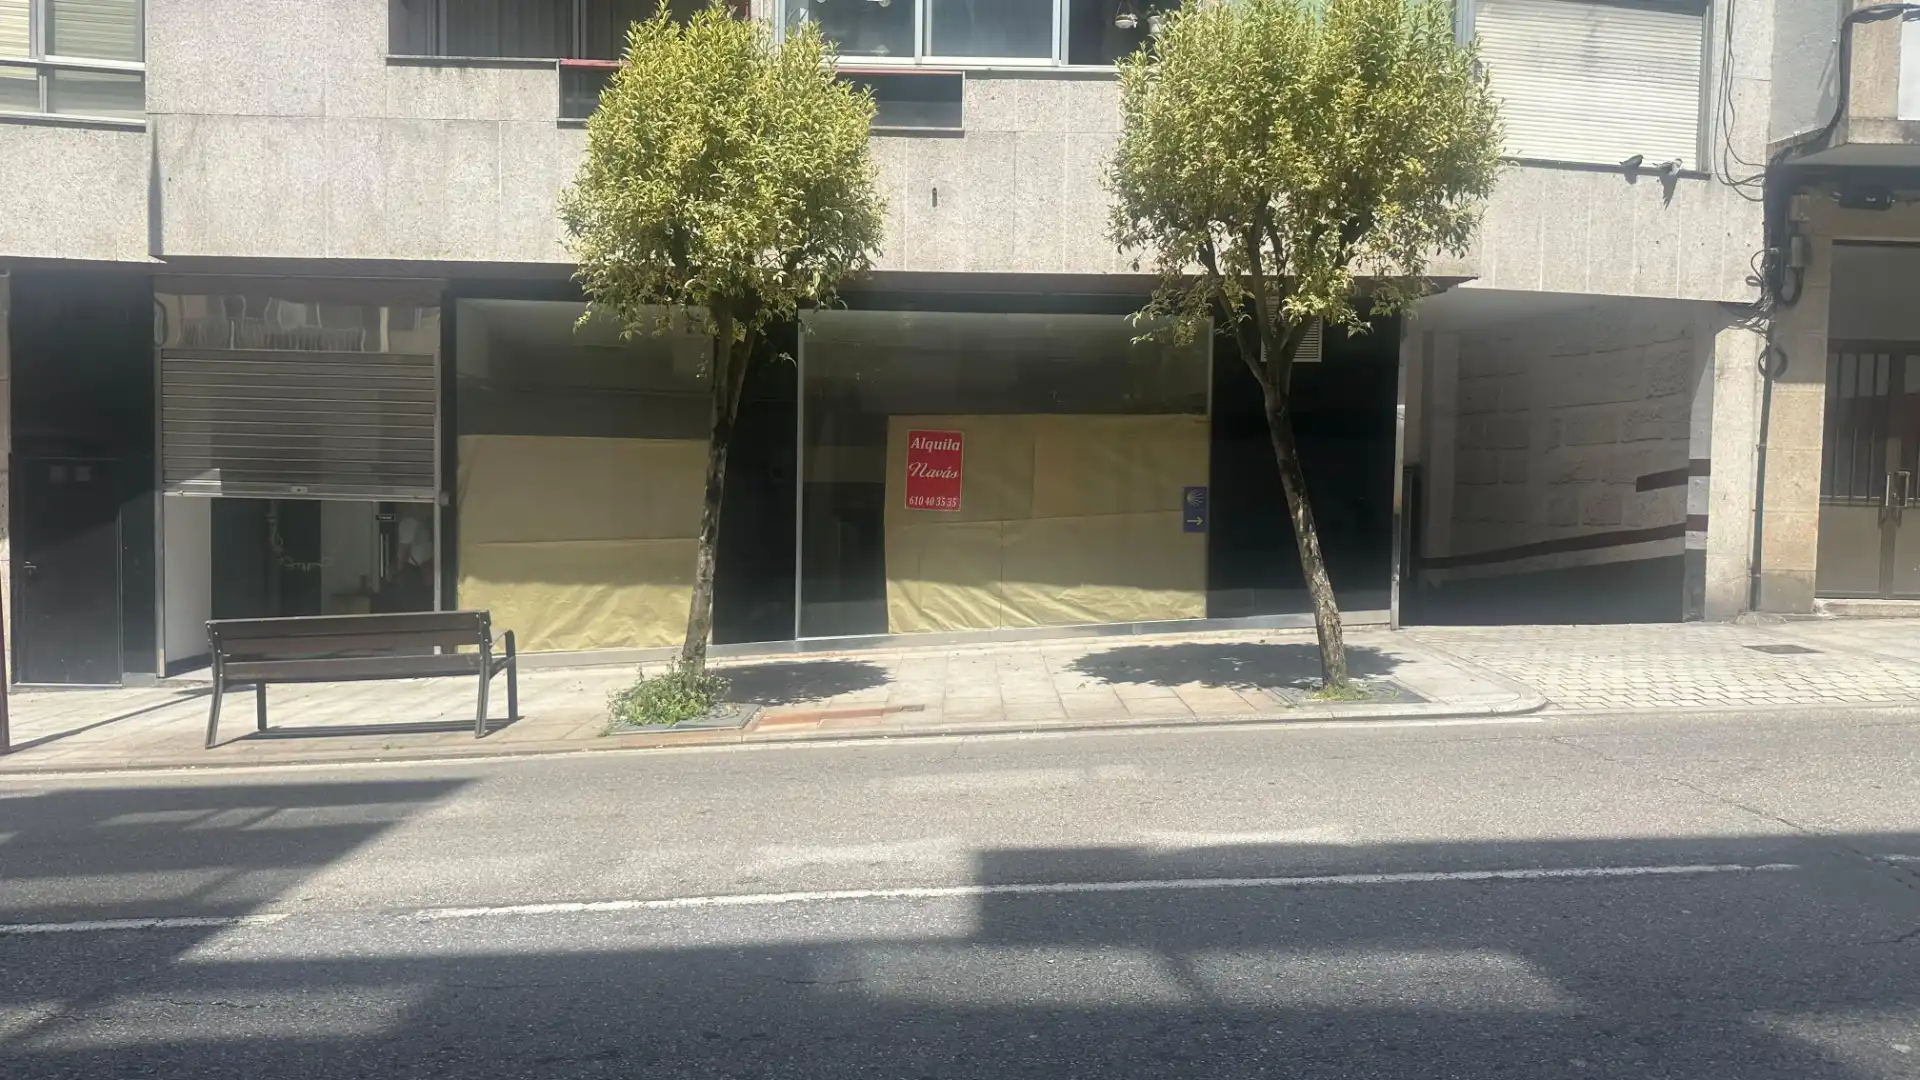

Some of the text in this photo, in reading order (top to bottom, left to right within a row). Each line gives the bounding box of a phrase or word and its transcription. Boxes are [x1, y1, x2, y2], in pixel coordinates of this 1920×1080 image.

[910, 437, 960, 453] Alquila
[909, 461, 959, 479] Navás
[909, 495, 924, 506] 610
